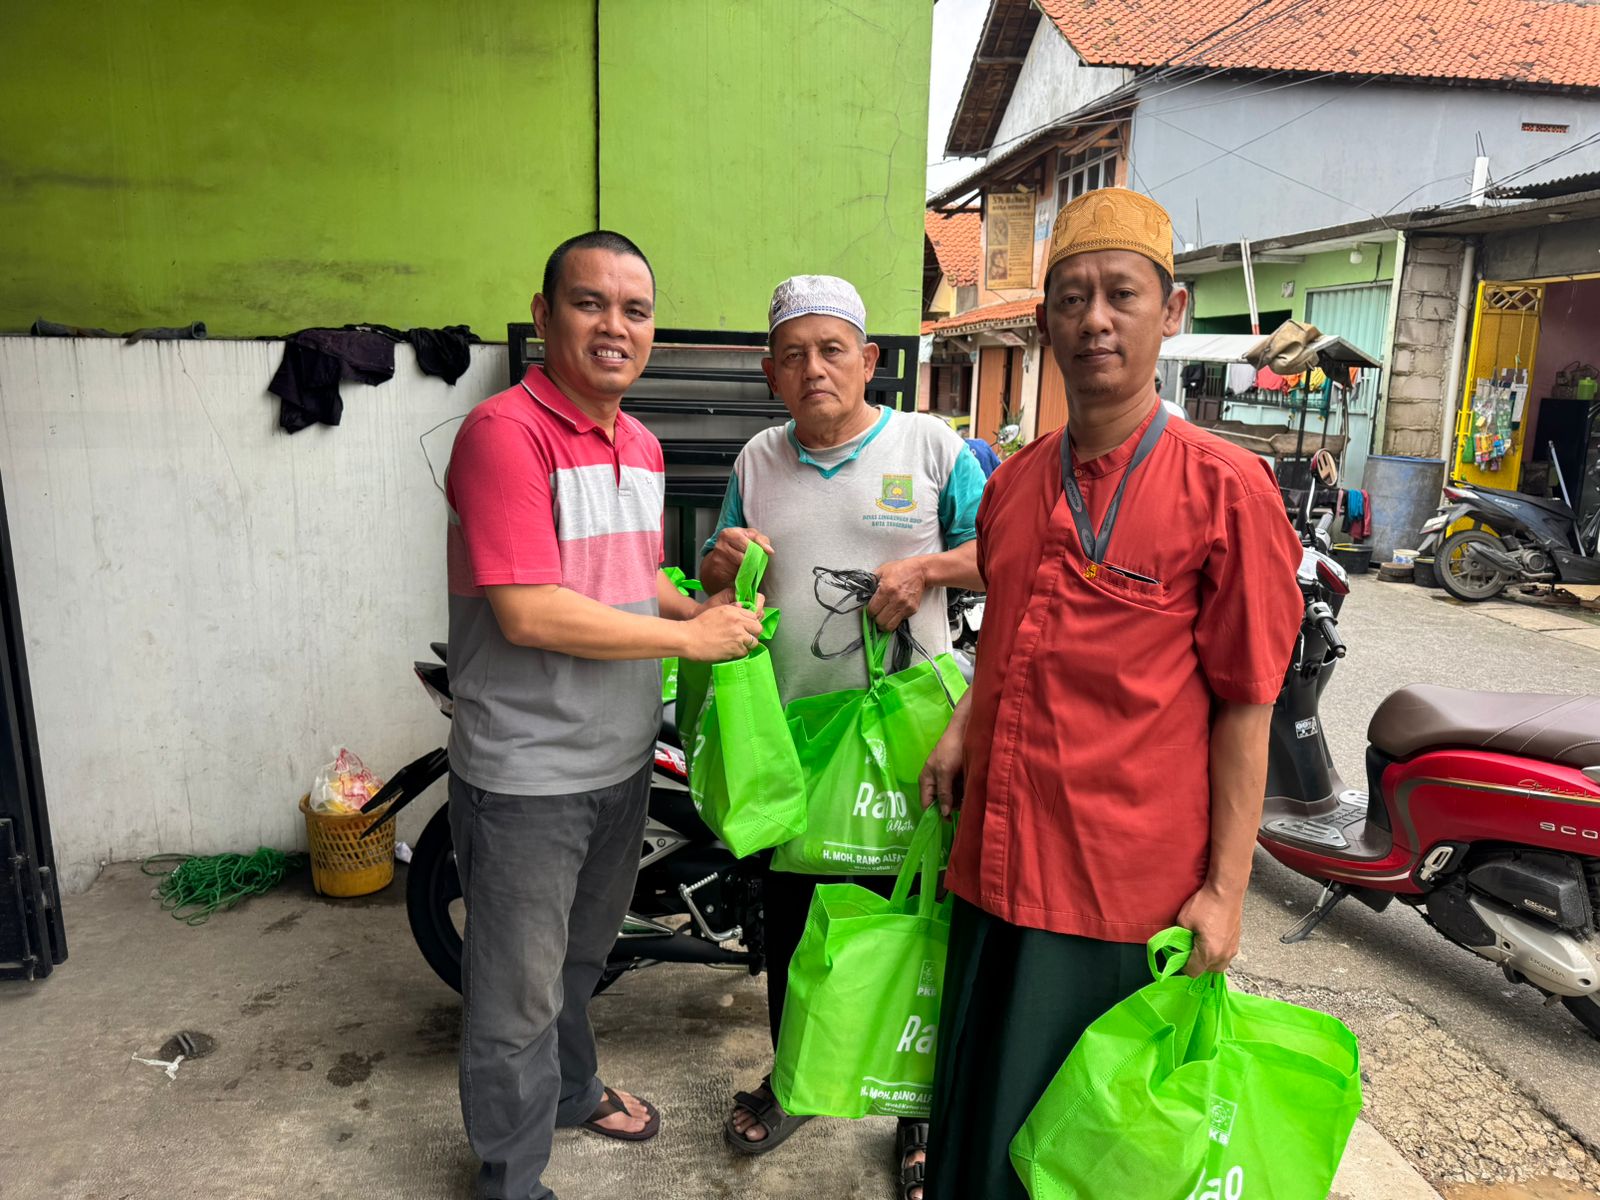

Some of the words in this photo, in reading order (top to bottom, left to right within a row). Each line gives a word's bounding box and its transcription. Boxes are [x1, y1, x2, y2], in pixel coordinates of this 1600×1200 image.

[823, 849, 832, 860] H.
[833, 851, 855, 863] MOH.
[856, 855, 881, 865] RANO
[892, 1091, 916, 1101] RANO
[1209, 1128, 1230, 1148] KB
